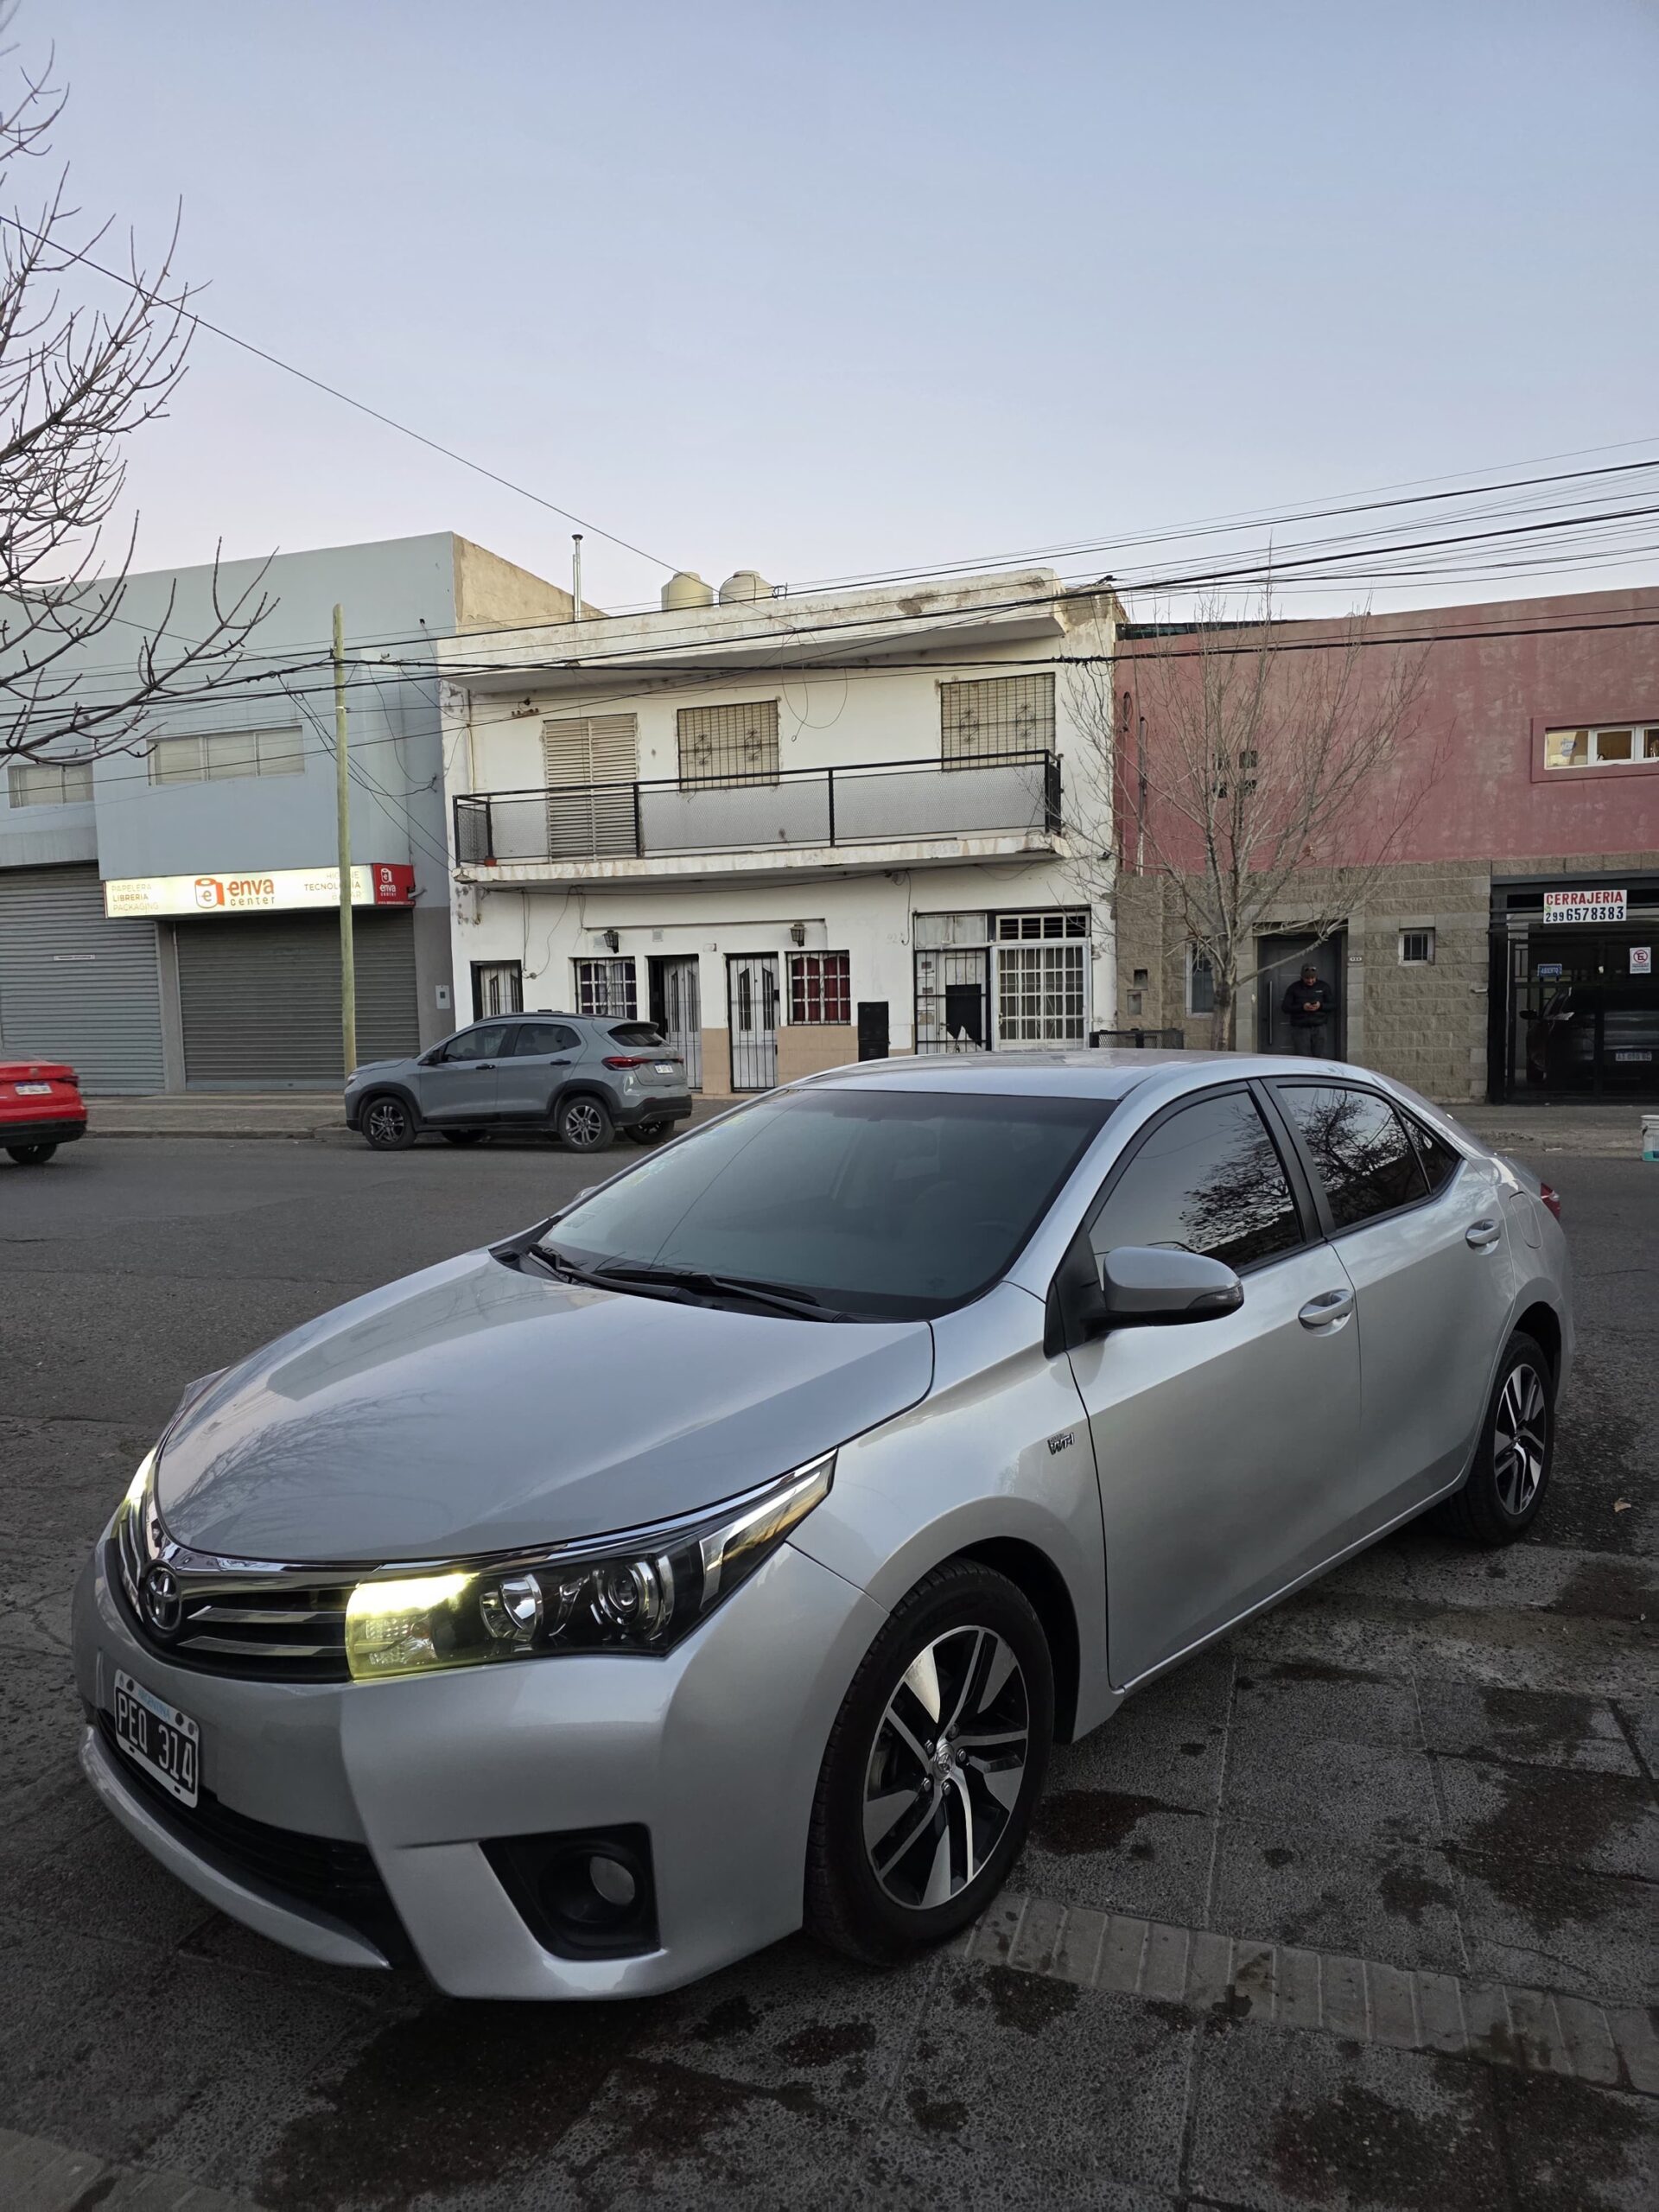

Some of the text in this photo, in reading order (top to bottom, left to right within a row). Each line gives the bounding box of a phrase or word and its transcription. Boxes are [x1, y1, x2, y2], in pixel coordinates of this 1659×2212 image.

[227, 879, 275, 896] enva
[230, 896, 275, 906] center
[1546, 892, 1624, 906] CERRAJERIA
[1567, 906, 1624, 921] 6578383
[158, 1724, 194, 1789] 314
